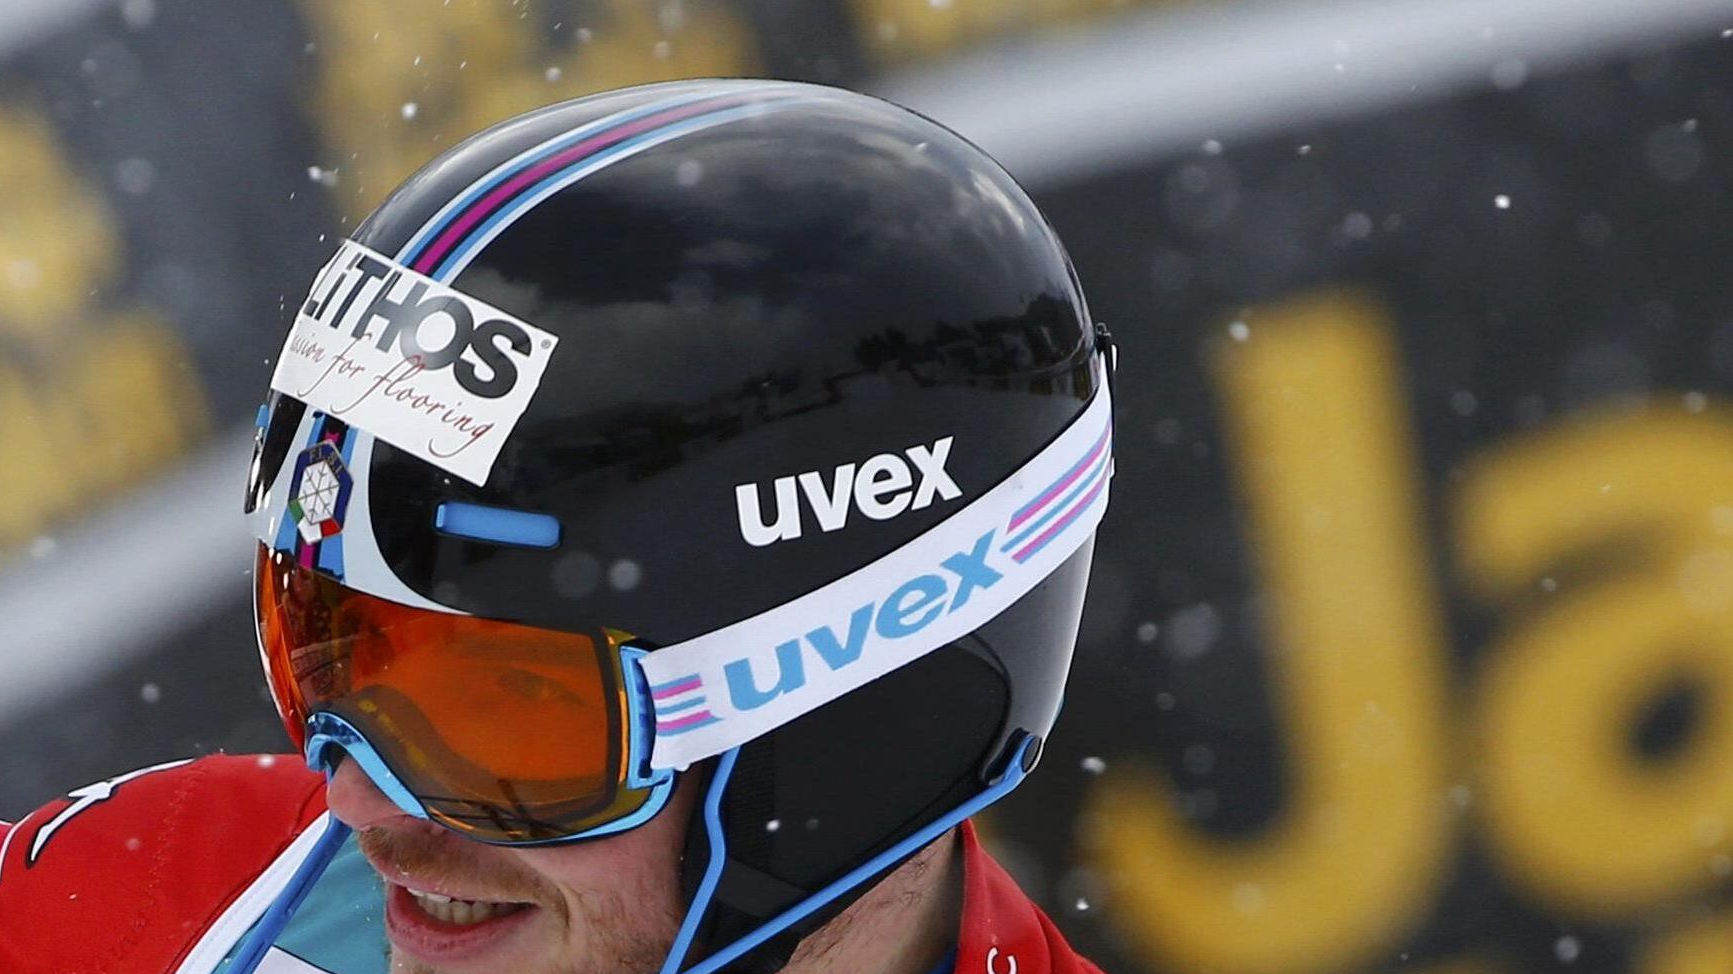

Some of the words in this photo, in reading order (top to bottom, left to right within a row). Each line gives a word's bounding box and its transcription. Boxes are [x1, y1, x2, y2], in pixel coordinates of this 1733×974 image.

[297, 333, 366, 397] for
[330, 354, 495, 458] flooring
[734, 435, 963, 547] uvex
[723, 527, 1004, 711] uvex
